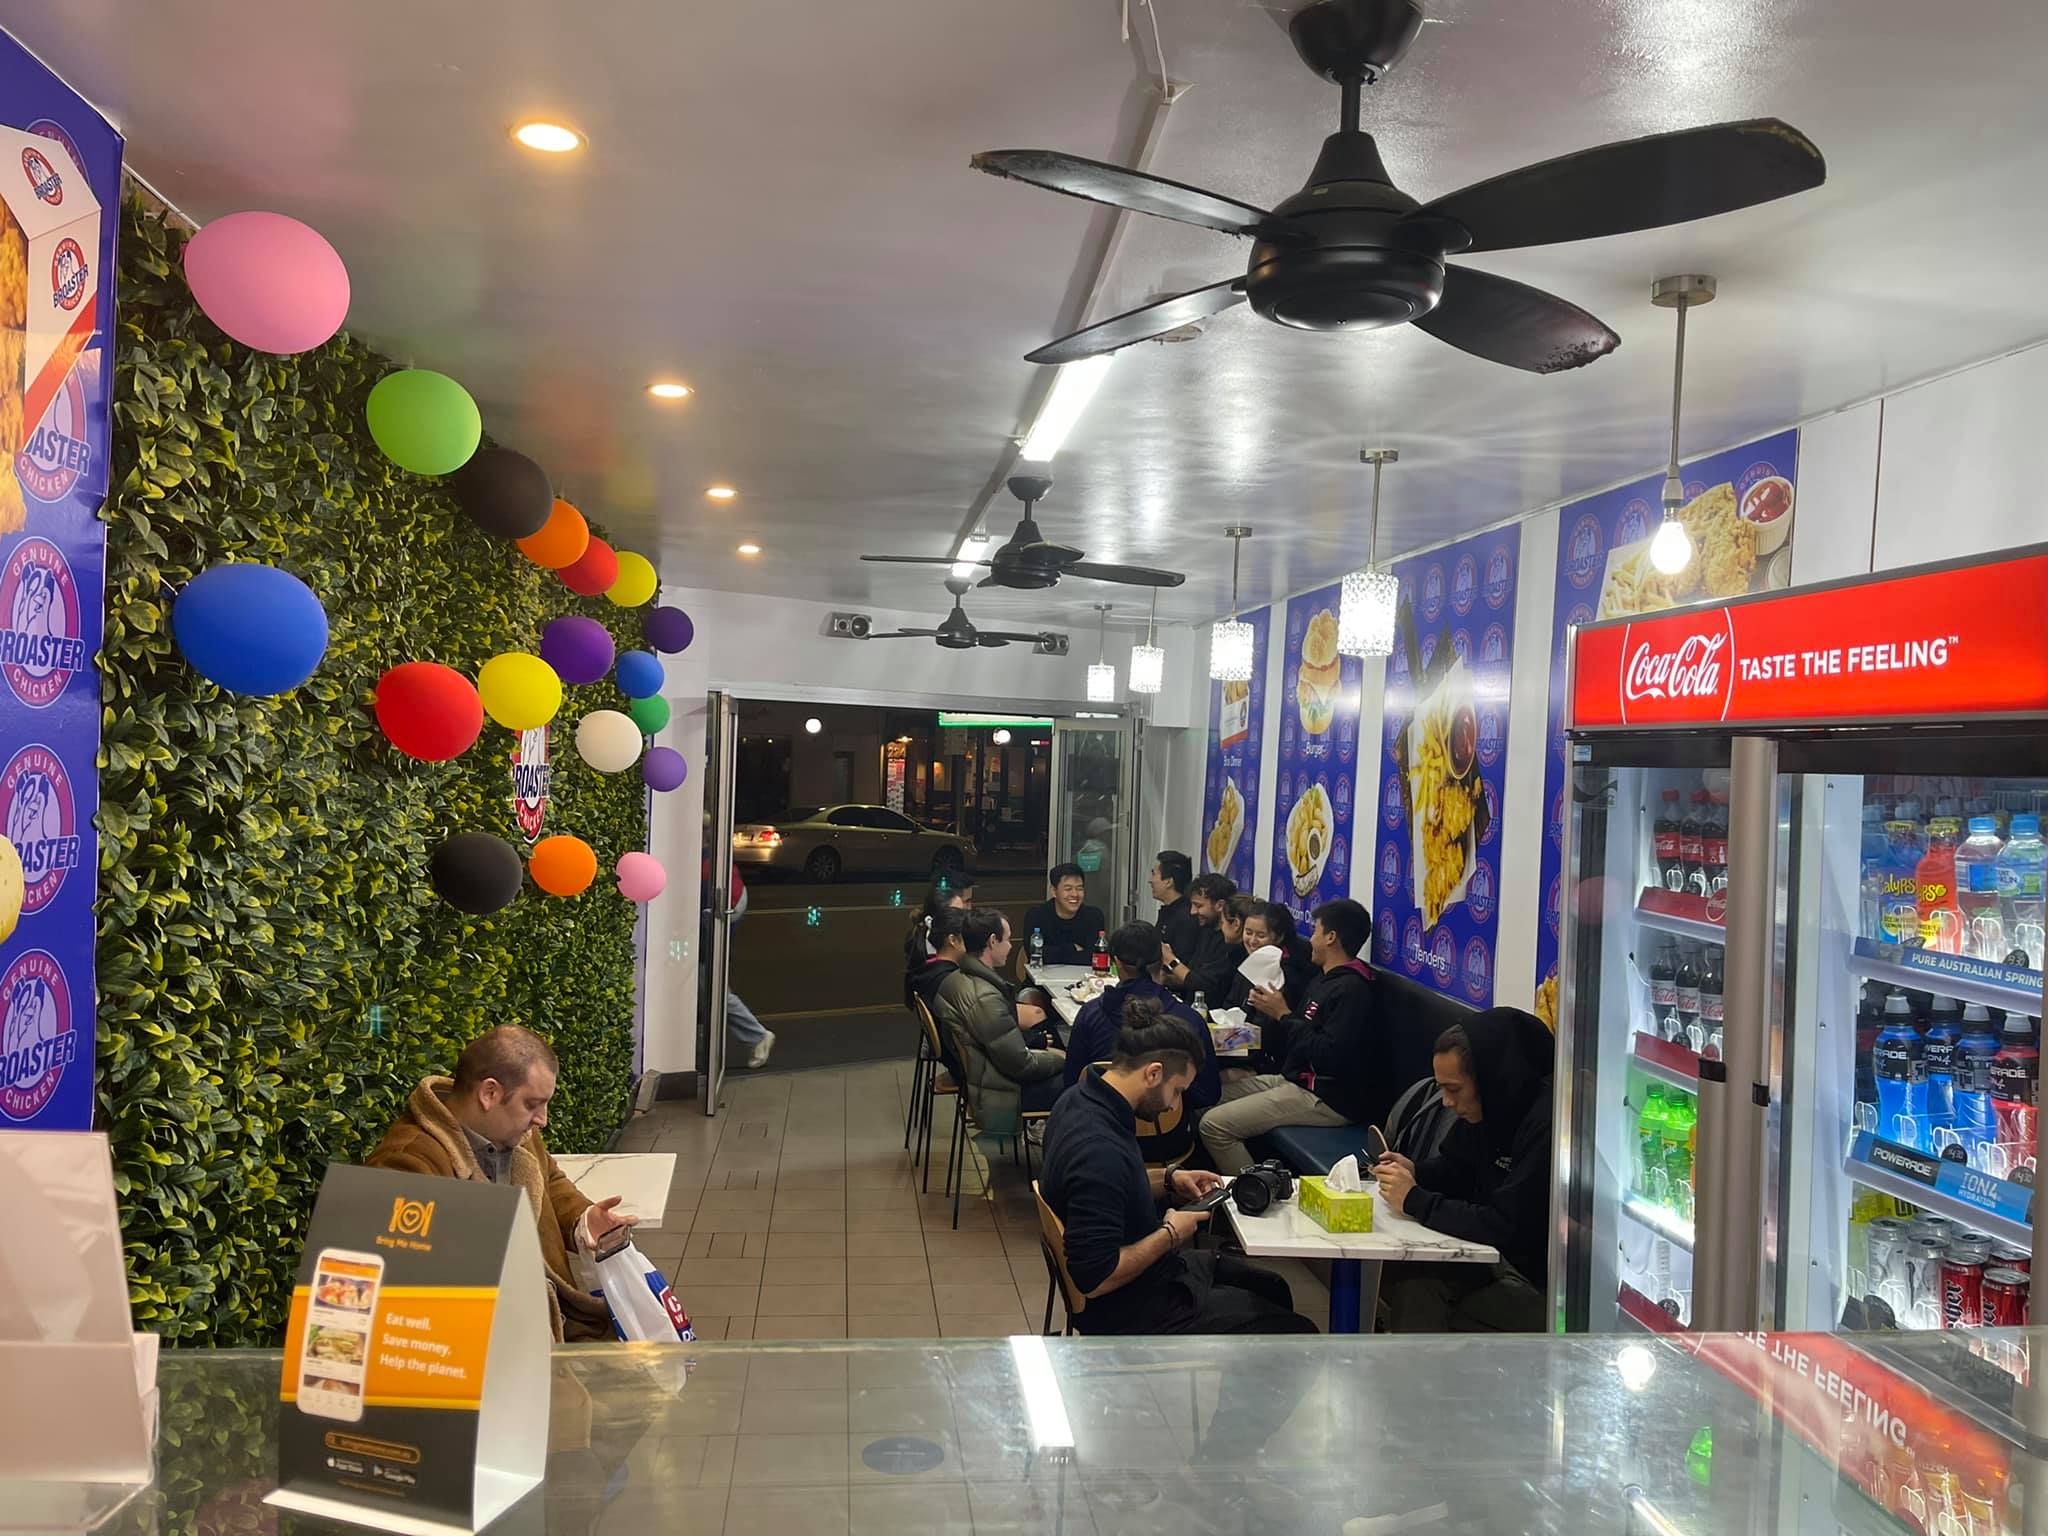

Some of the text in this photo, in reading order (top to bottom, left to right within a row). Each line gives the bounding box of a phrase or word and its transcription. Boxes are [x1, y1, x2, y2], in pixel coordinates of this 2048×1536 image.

[53, 264, 89, 308] BROASTER
[25, 426, 91, 475] ASTER
[20, 457, 69, 492] CHICKEN
[12, 547, 69, 587] GENUINE
[1626, 631, 1728, 701] Coca-Cola
[1740, 653, 1795, 681] TASTE
[1801, 648, 1840, 676] THE
[13, 668, 63, 698] CHICKEN
[7, 753, 63, 789] GENUINE
[1413, 943, 1447, 971] Tenders
[1912, 953, 2044, 989] PURE AUSTRALIAN SPRING
[3, 959, 59, 1001] GENUINE
[5, 1072, 55, 1111] CHICKEN
[1873, 1147, 1932, 1177] POWERADE
[1957, 1189, 1997, 1208] HYDRATION
[1960, 1172, 1999, 1200] ION4
[375, 1235, 395, 1248] Bring
[409, 1240, 433, 1252] Home
[385, 1312, 432, 1331] Eat well.
[382, 1332, 452, 1358] Save money.
[379, 1353, 468, 1380] Help the planet.
